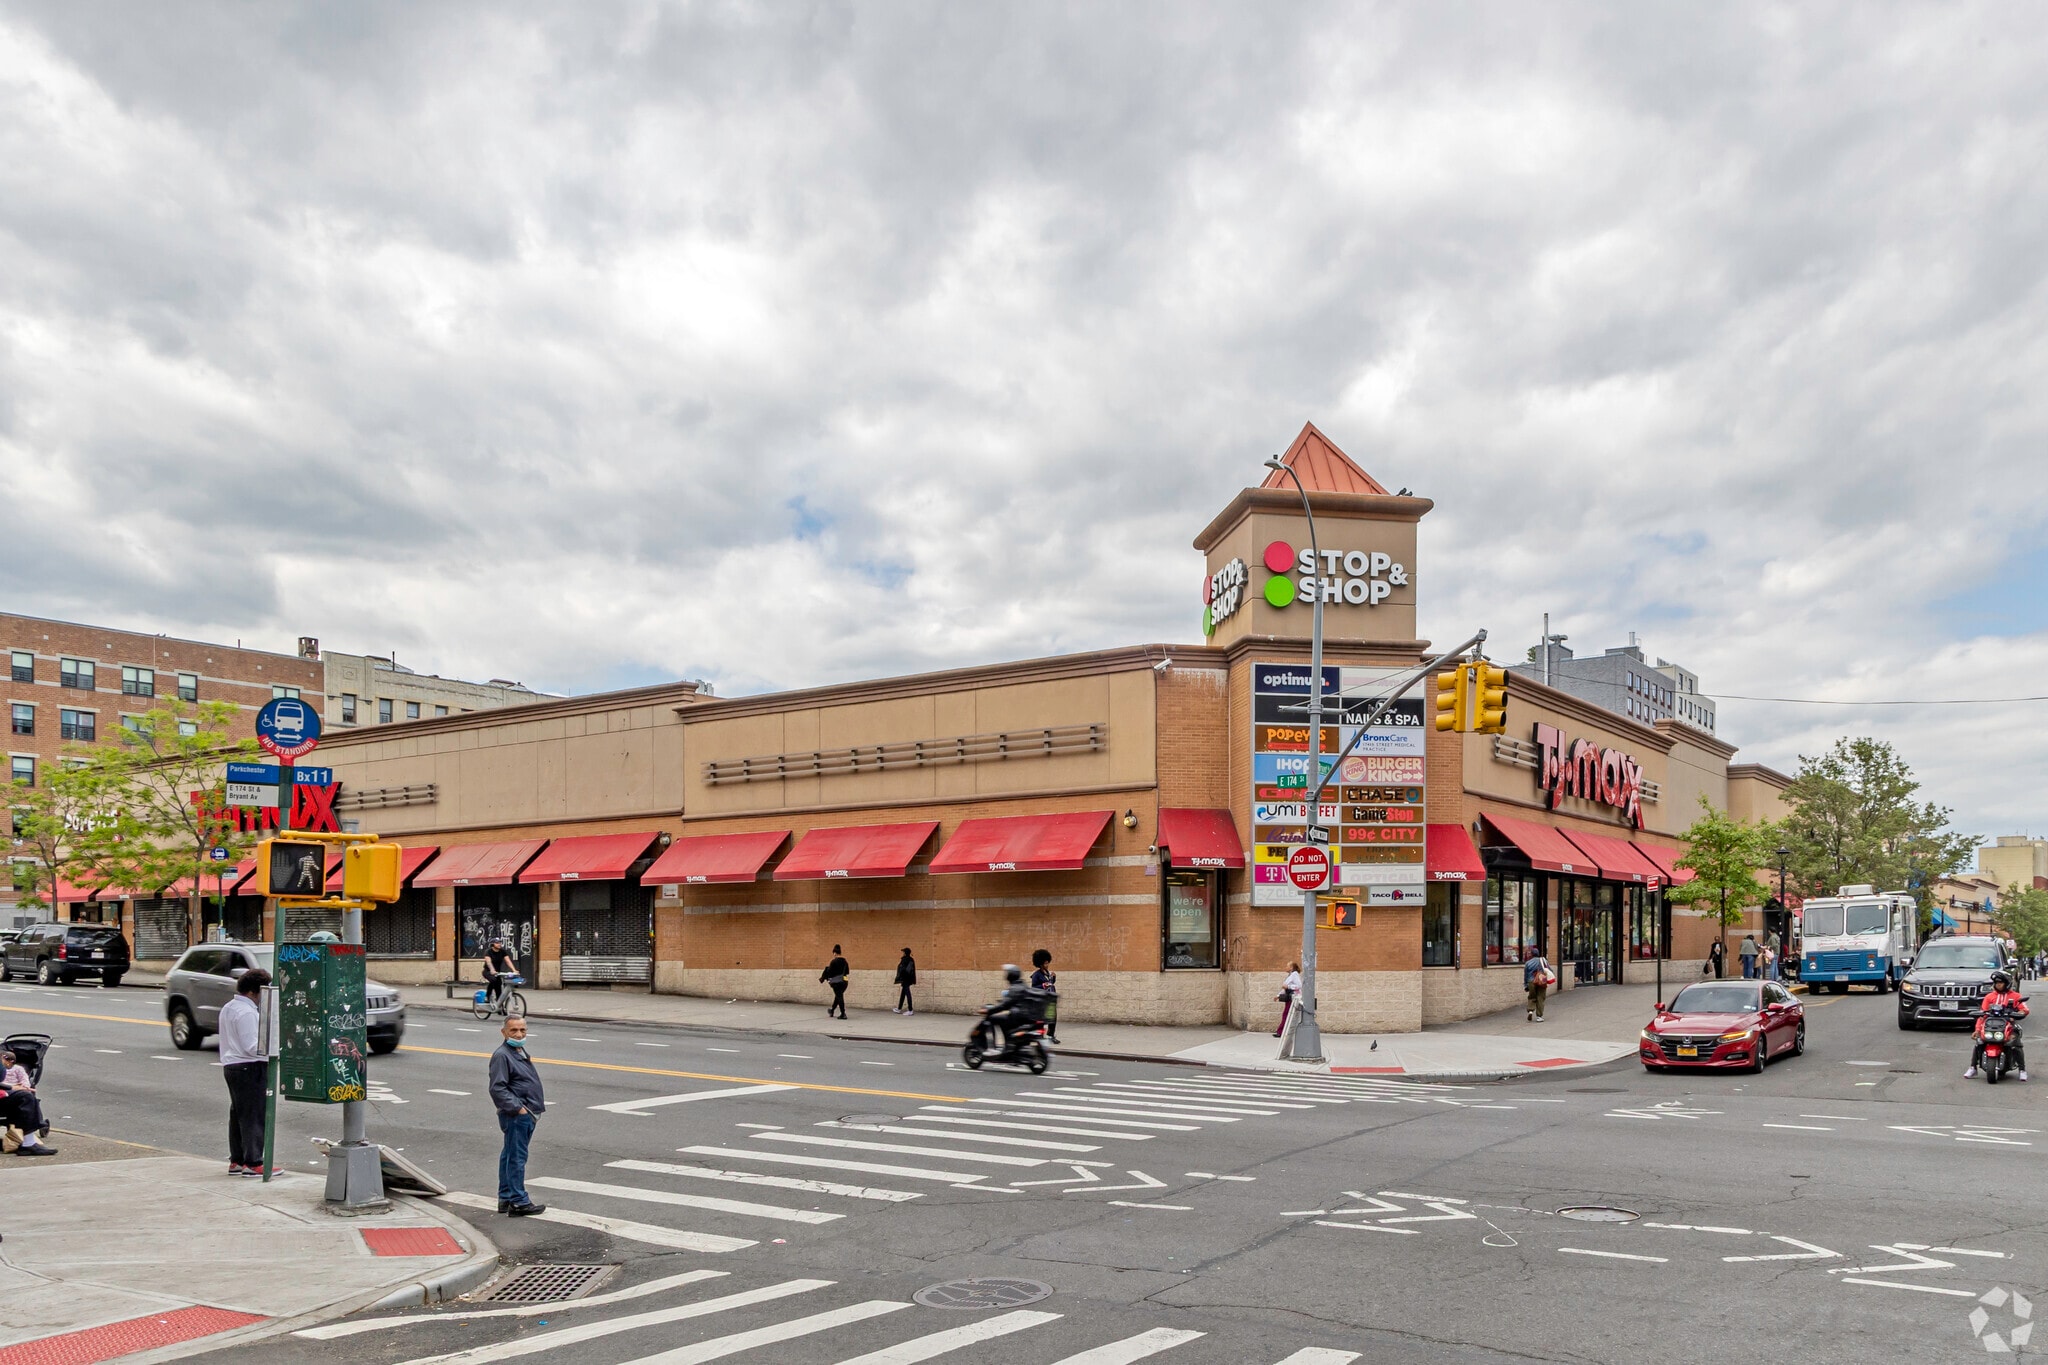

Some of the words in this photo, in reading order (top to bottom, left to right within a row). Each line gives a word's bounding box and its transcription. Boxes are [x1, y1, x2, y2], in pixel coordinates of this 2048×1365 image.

[1298, 576, 1392, 605] SHOP
[1211, 585, 1243, 625] SHOP
[1384, 714, 1393, 725] &
[1395, 715, 1420, 726] SPA
[1363, 733, 1408, 742] BronxCare
[262, 737, 275, 748] NO
[274, 740, 314, 755] STANDING
[229, 765, 266, 774] Parkchester
[1368, 757, 1423, 770] BURGER
[296, 769, 328, 783] Bx11
[1280, 776, 1285, 787] E
[1287, 776, 1298, 786] 174
[1368, 770, 1403, 782] KING
[229, 791, 249, 800] Bryant
[1347, 788, 1405, 801] CHASE
[1300, 805, 1337, 817] BFET
[1353, 806, 1415, 821] GameStop
[1381, 828, 1418, 841] CITY
[1294, 855, 1304, 863] DO
[1308, 854, 1323, 863] NOT
[1296, 873, 1320, 882] ENTER
[1173, 897, 1204, 906] we're
[1173, 908, 1202, 919] open
